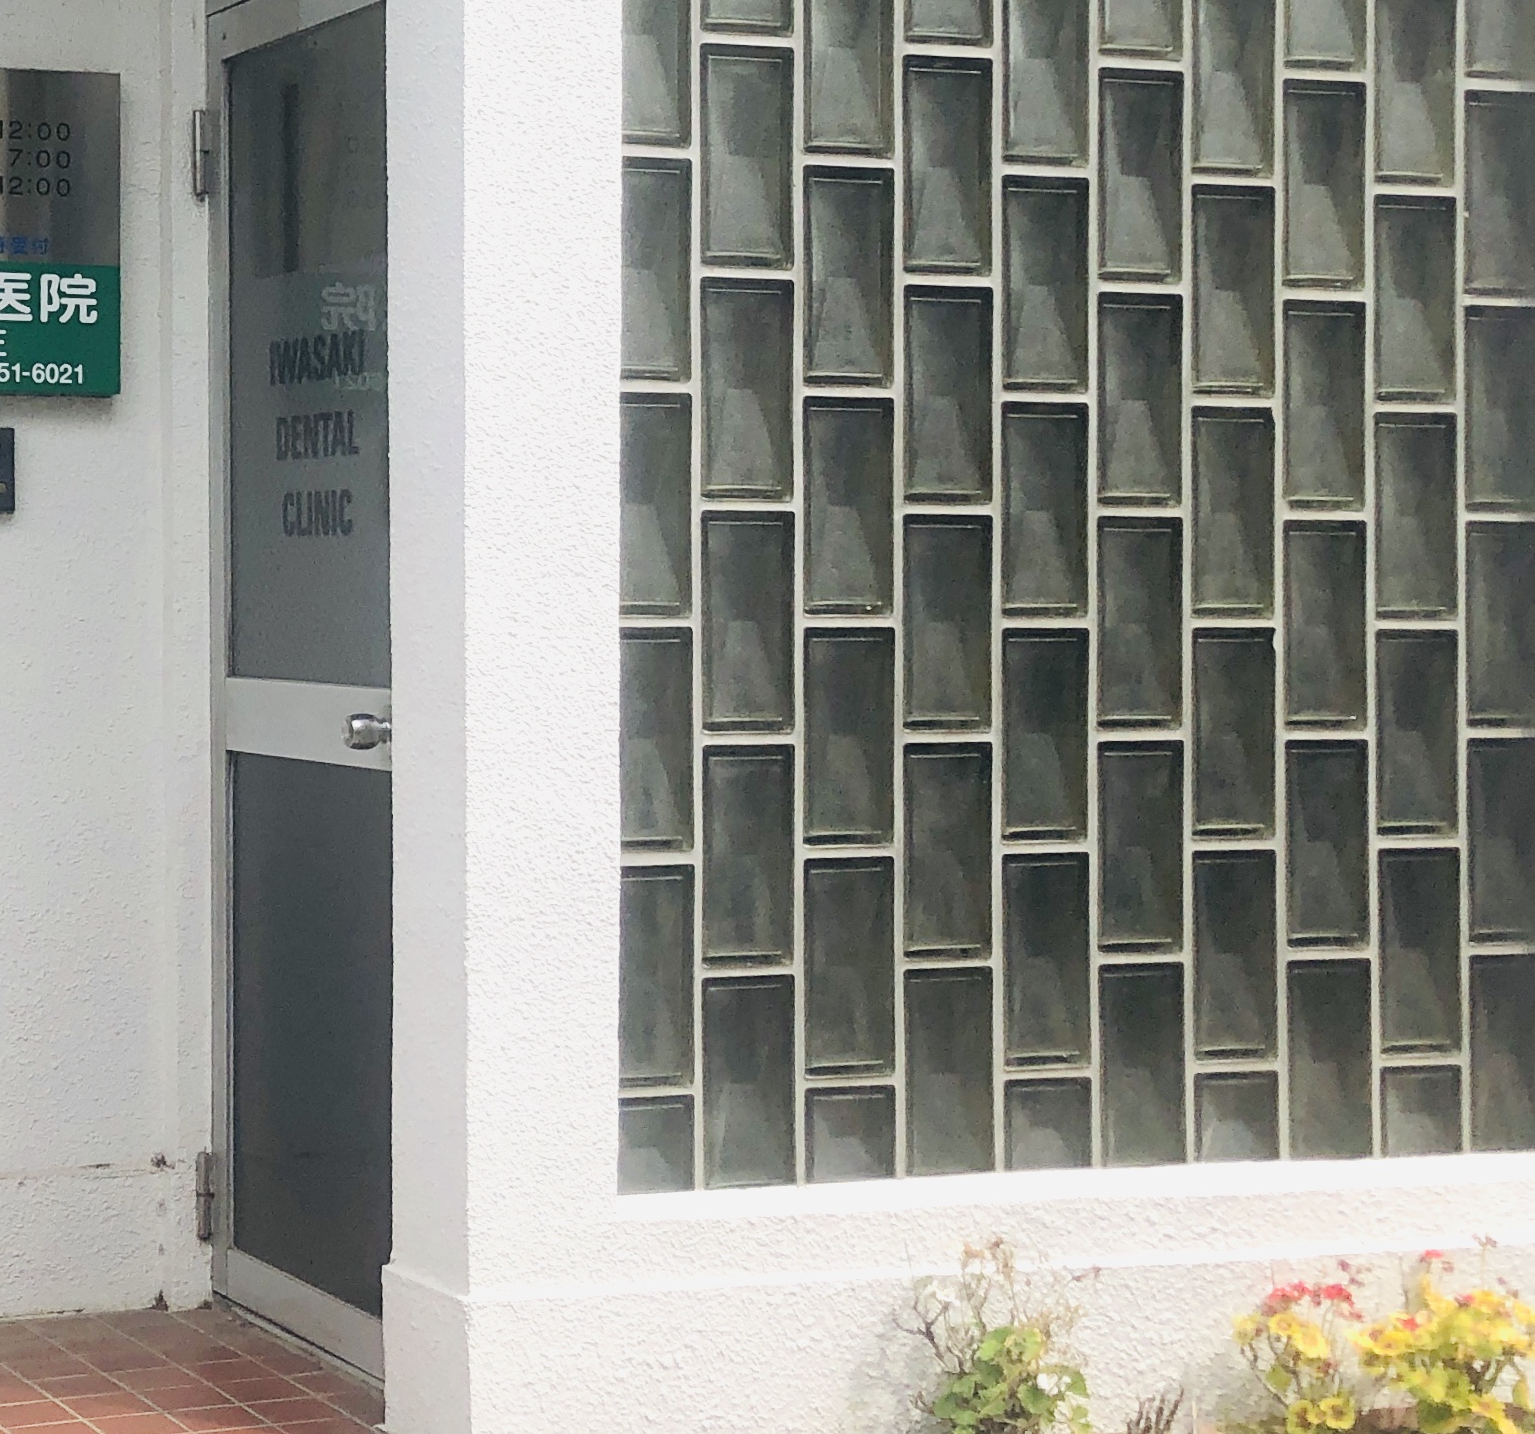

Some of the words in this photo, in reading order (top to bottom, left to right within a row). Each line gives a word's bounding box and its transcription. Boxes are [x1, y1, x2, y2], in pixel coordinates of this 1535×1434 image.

[269, 329, 365, 387] IWASAKI
[275, 409, 359, 461] DENTAL
[281, 488, 353, 538] CLINIC
